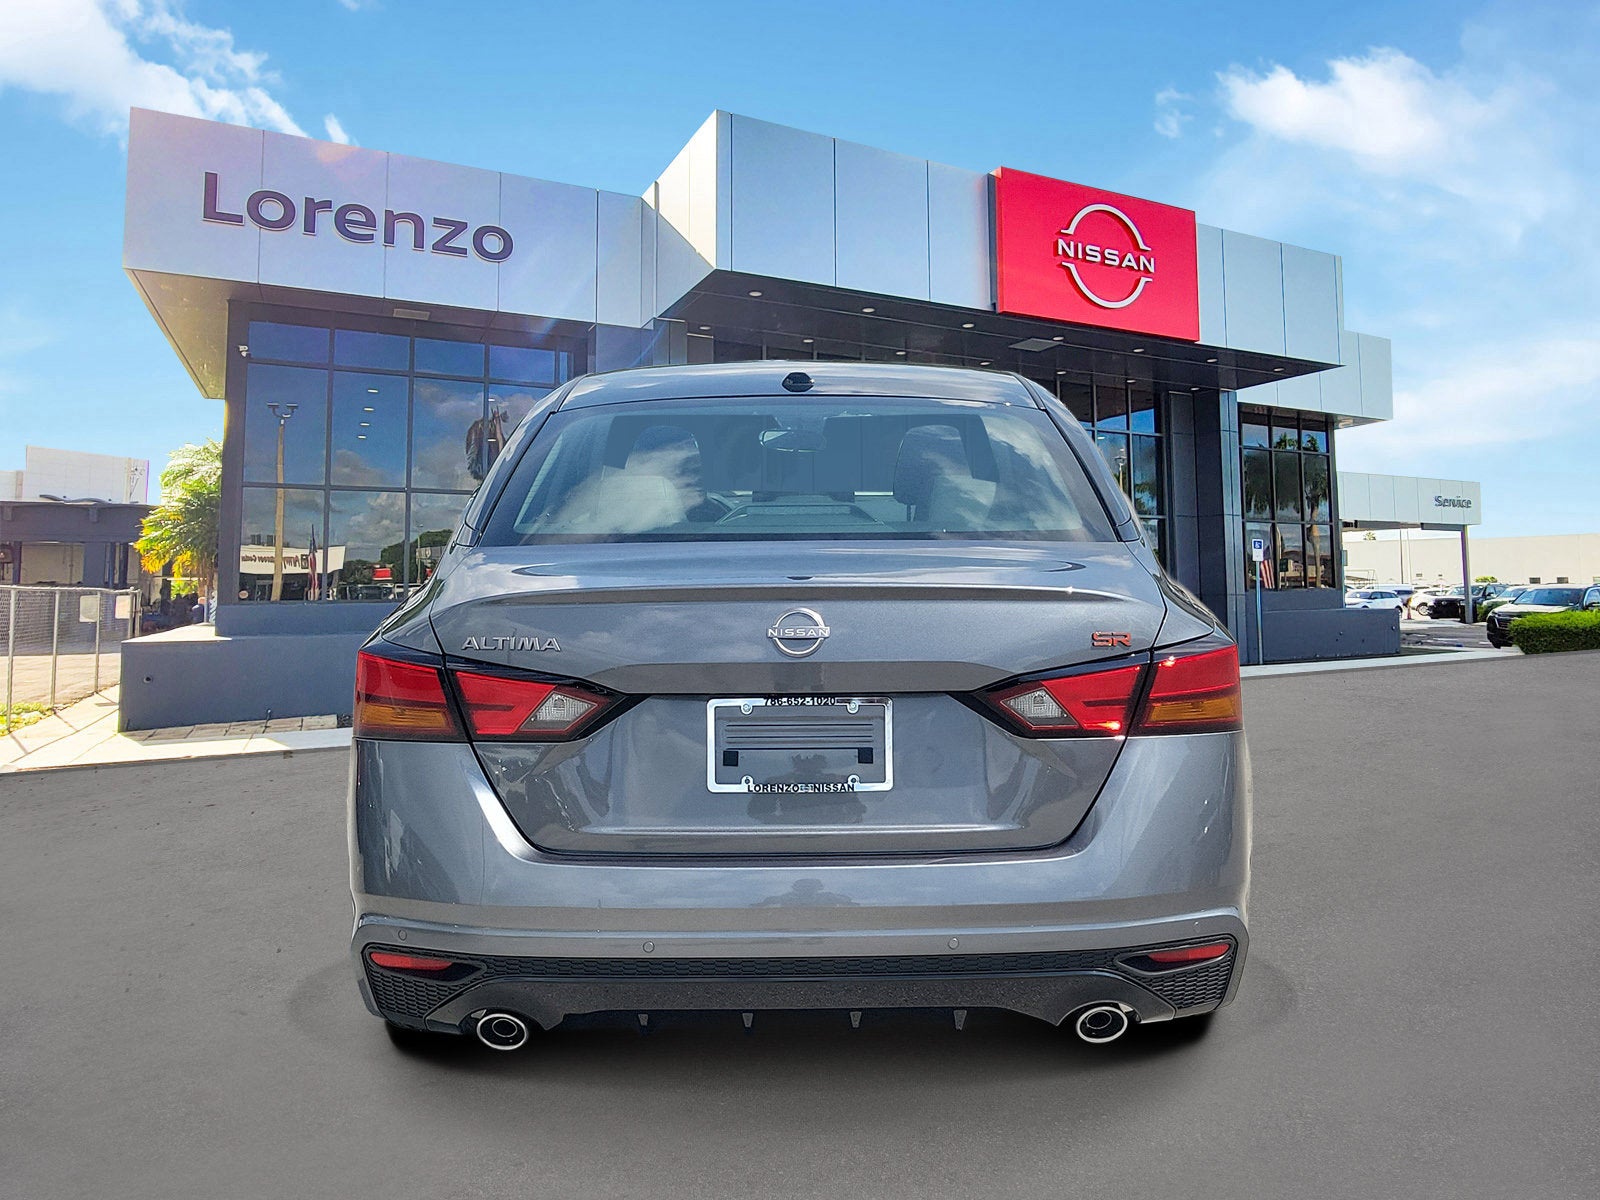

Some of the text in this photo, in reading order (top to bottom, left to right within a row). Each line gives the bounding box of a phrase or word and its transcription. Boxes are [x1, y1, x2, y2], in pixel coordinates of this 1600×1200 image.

[202, 170, 514, 263] Lorenzo
[1057, 238, 1155, 273] NISSAN
[1434, 495, 1472, 508] Service
[768, 628, 829, 637] NISSAN
[1091, 631, 1131, 647] SR
[461, 636, 560, 651] ALTIMA
[763, 697, 836, 706] 786-652-1020
[747, 783, 799, 793] LORENZO
[814, 783, 855, 793] NISSAN
